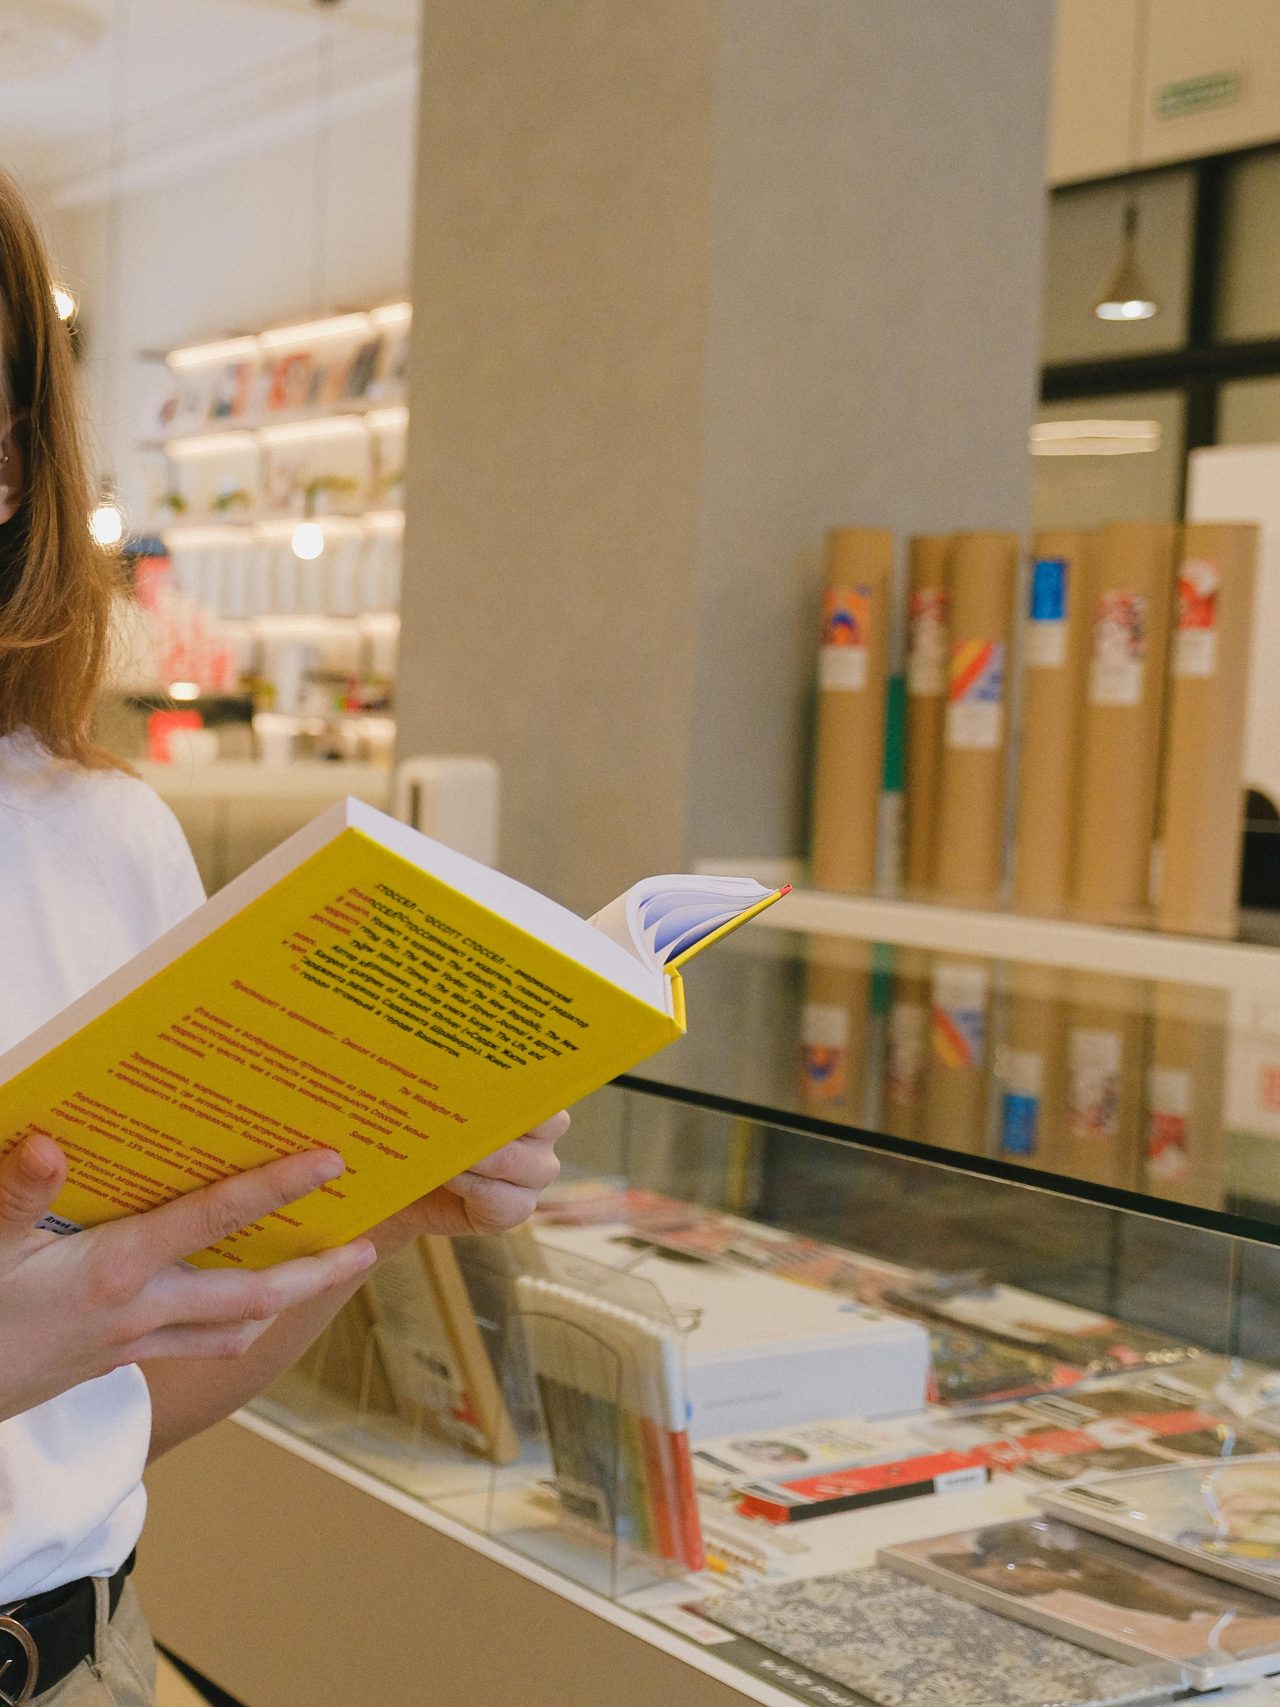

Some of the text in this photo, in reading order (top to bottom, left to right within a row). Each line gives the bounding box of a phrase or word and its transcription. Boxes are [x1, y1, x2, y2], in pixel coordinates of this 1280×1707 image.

[447, 959, 462, 971] The
[499, 989, 545, 1017] Печатается
[513, 969, 573, 1003] американский
[381, 998, 429, 1026] Сарджента
[419, 960, 439, 972] New
[471, 989, 487, 999] The
[487, 999, 506, 1010] New
[506, 1009, 542, 1032] Republic,
[545, 1030, 560, 1040] The
[560, 1039, 578, 1050] New
[434, 982, 449, 993] The
[450, 992, 471, 1004] Wall
[469, 1003, 497, 1019] Street
[495, 1019, 528, 1036] Journal
[549, 1005, 588, 1027] редактор
[383, 1014, 413, 1031] городе
[397, 992, 431, 1012] Sargent
[431, 1011, 461, 1028] Shriver
[500, 1048, 526, 1065] Жизнь
[414, 988, 441, 1004] Автор
[496, 1031, 510, 1042] The
[511, 1040, 527, 1051] Life
[527, 1050, 545, 1060] and
[399, 1087, 467, 1122] The Washington Post
[127, 1141, 143, 1150] 15%
[349, 1131, 407, 1159] Sunday Telegraph
[222, 1252, 242, 1262] Claire
